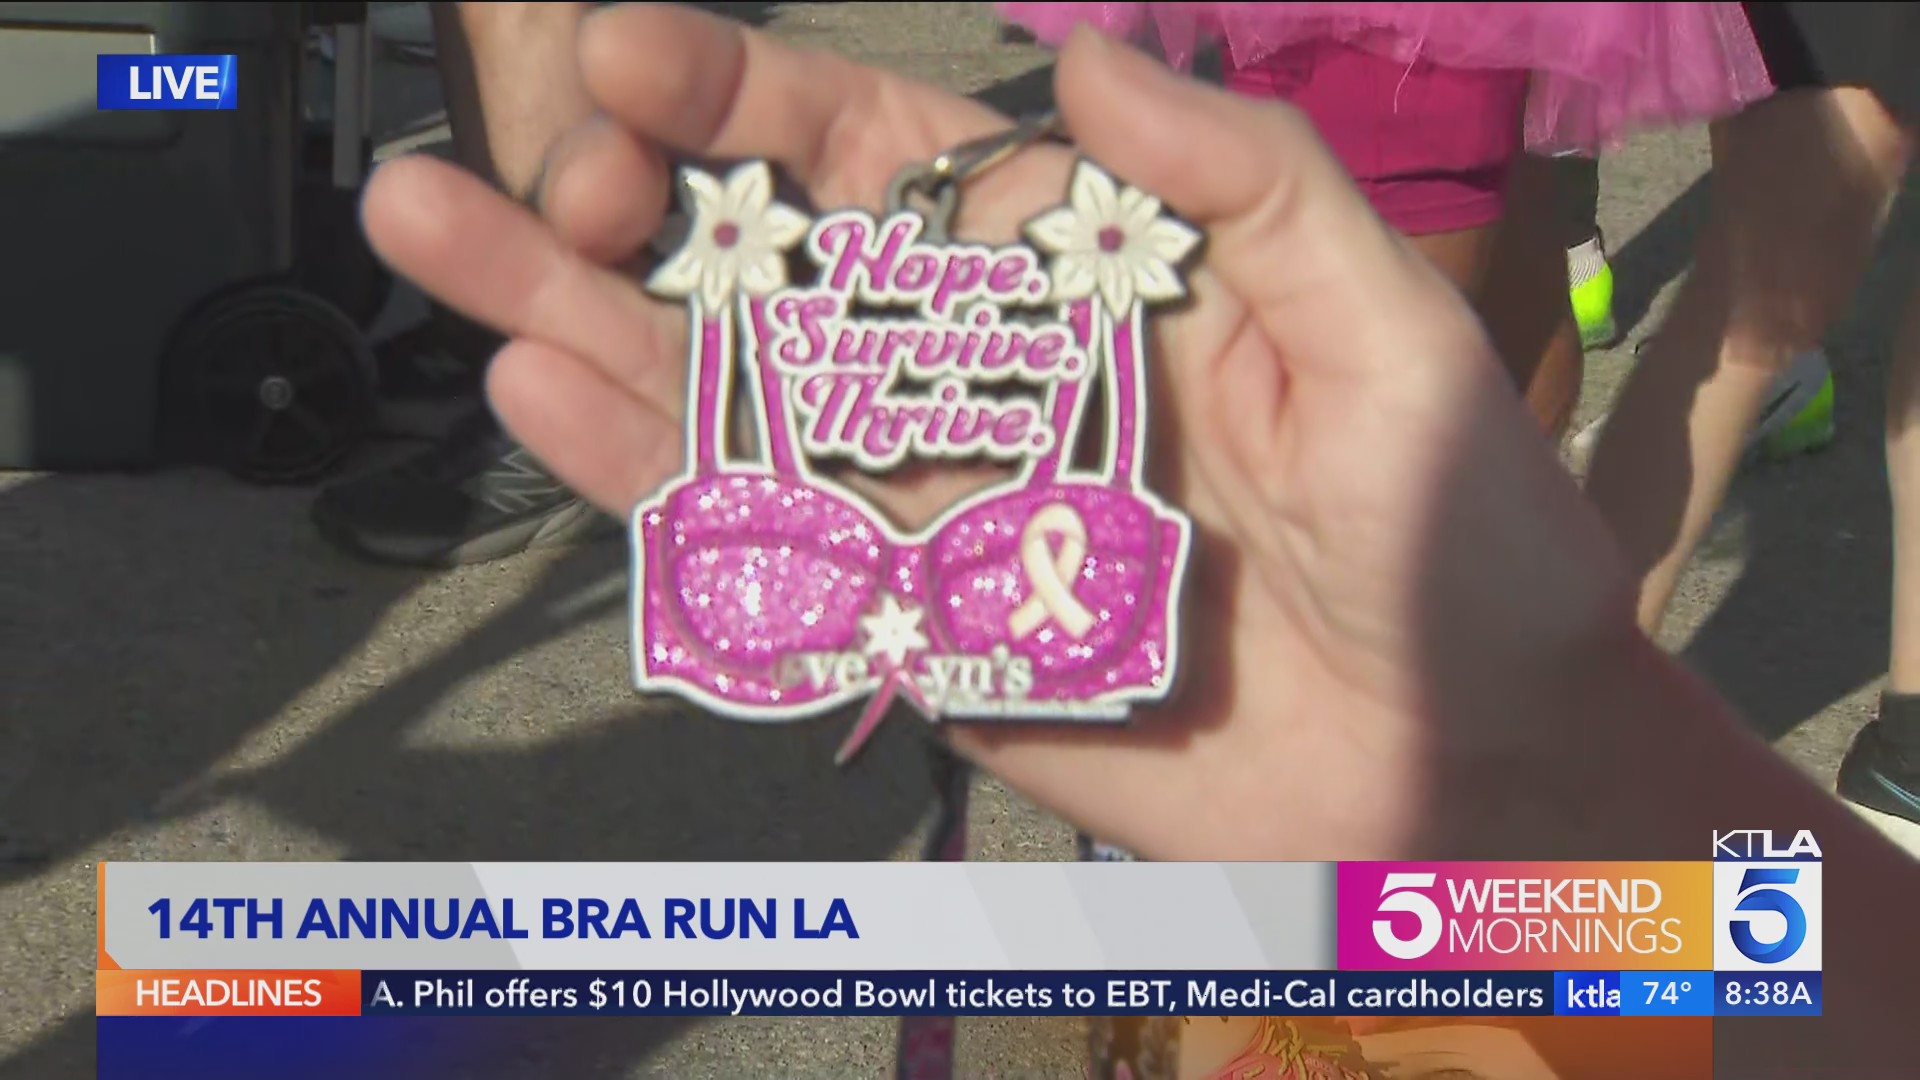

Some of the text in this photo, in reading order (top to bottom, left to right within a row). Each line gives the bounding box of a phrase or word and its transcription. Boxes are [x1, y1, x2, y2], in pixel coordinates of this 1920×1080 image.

[816, 218, 1043, 313] Hope.
[774, 298, 1082, 370] Survive.
[803, 374, 1047, 456] Thrive.
